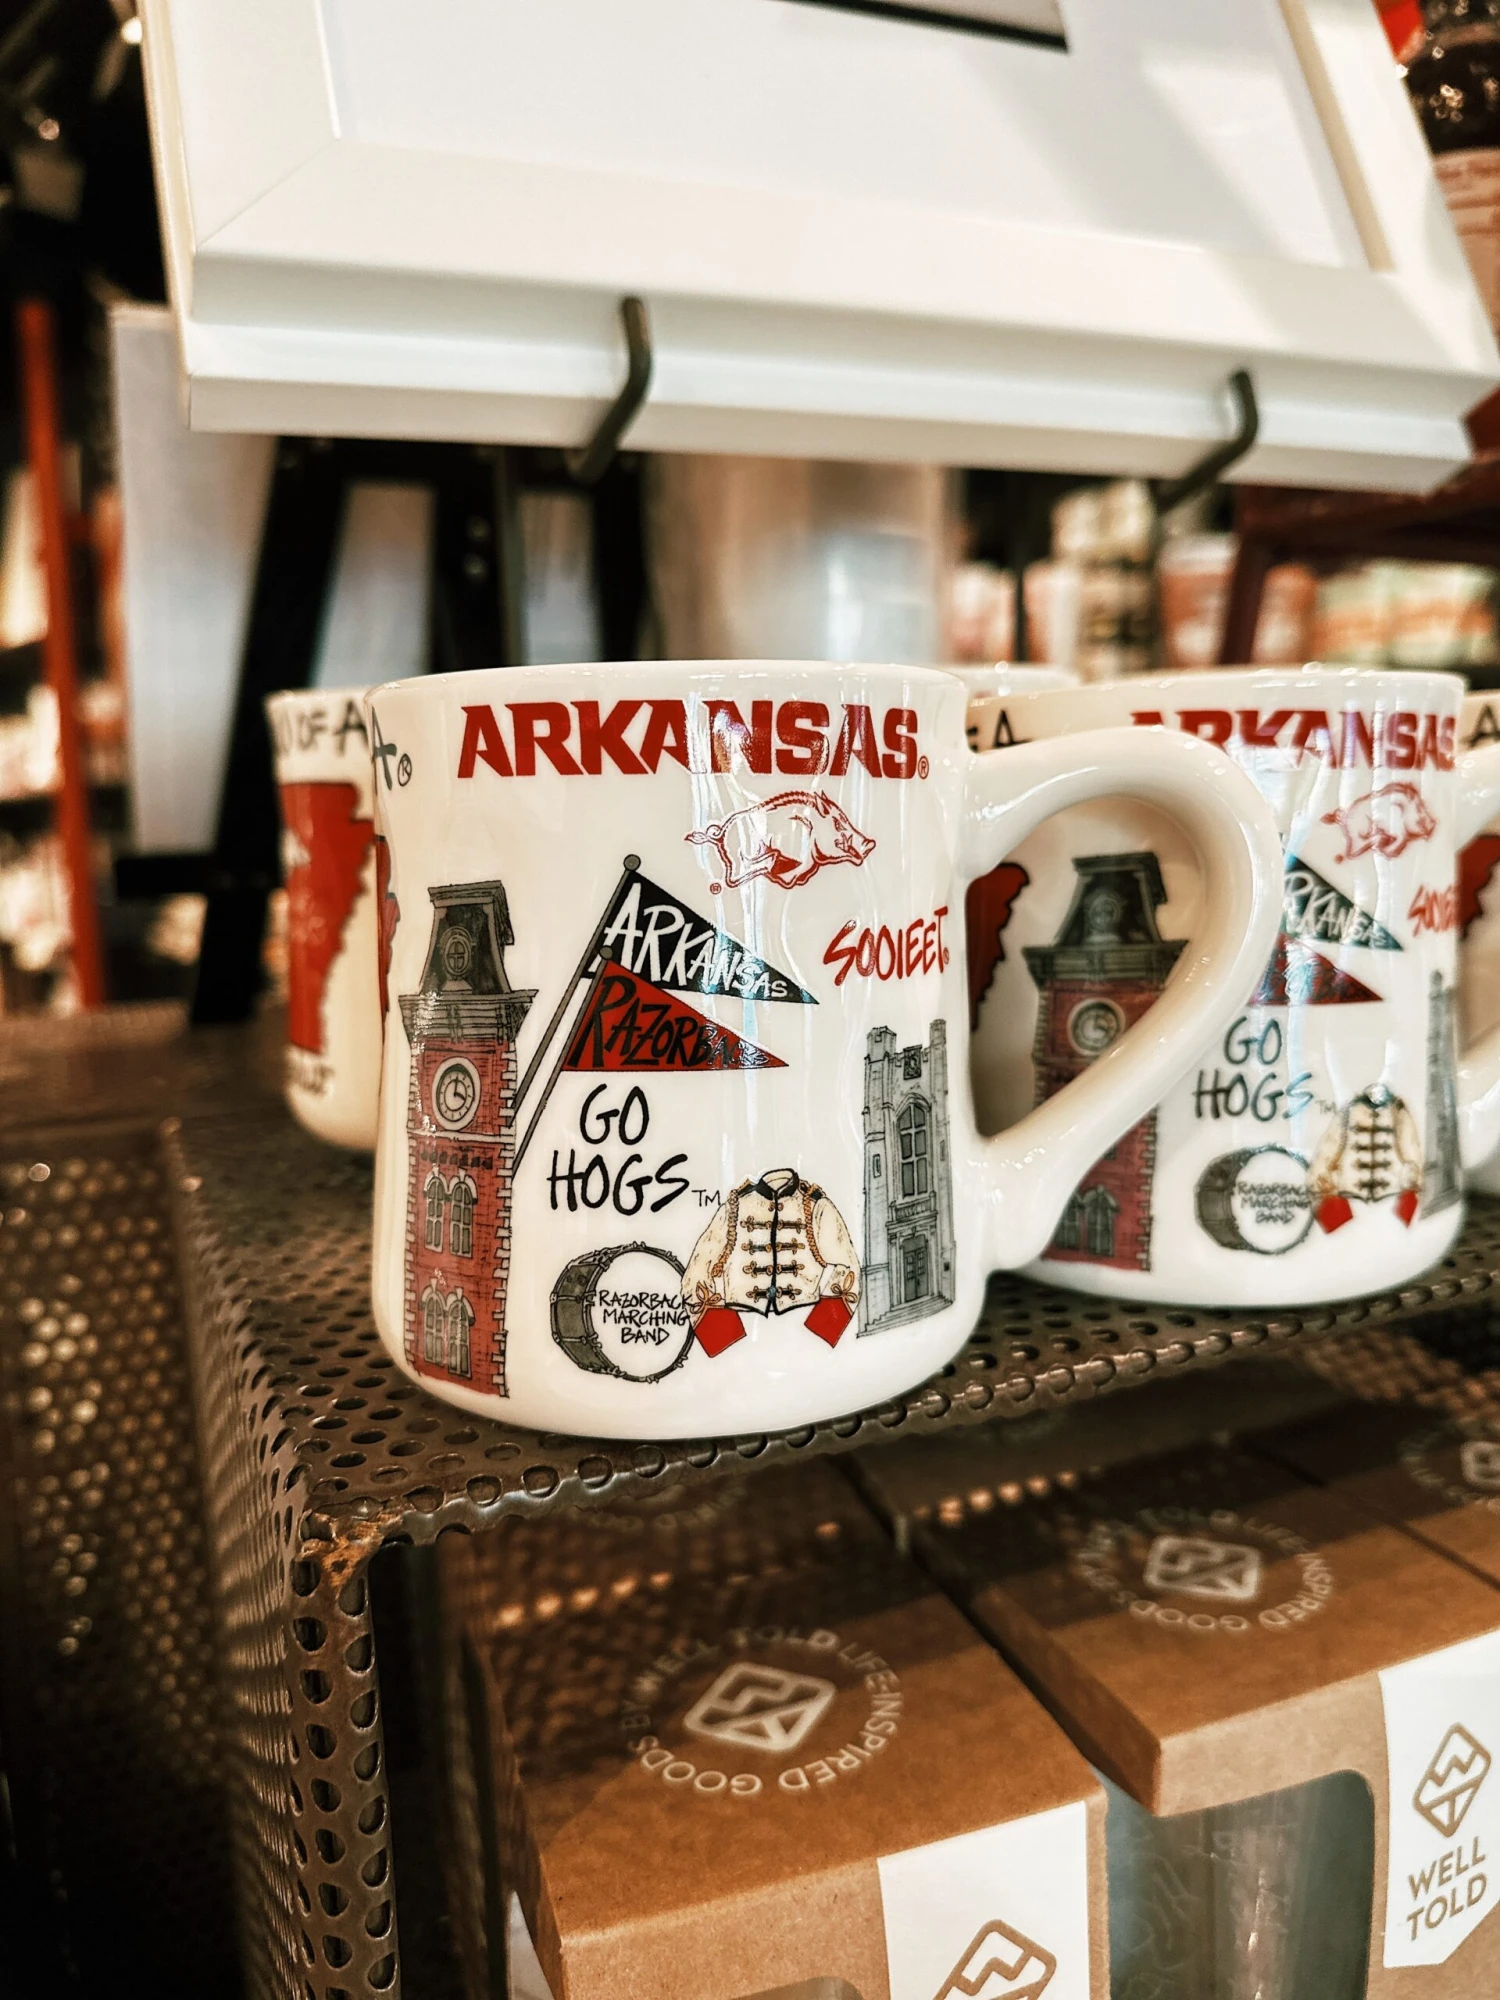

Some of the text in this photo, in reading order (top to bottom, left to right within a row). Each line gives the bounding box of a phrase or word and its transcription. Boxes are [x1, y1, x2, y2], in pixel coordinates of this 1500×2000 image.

[588, 882, 789, 998] ARKANSAS
[1223, 1015, 1282, 1065] GO
[579, 1082, 650, 1146] GO
[1192, 1068, 1314, 1122] HOGS
[546, 1148, 690, 1216] HOGS
[599, 1289, 696, 1311] RAZORBACK
[602, 1308, 691, 1328] MARCHING
[620, 1326, 670, 1346] BAND
[627, 1734, 763, 1797] GOODS
[1408, 1836, 1486, 1900] WELL
[1407, 1872, 1487, 1941] TOLD
